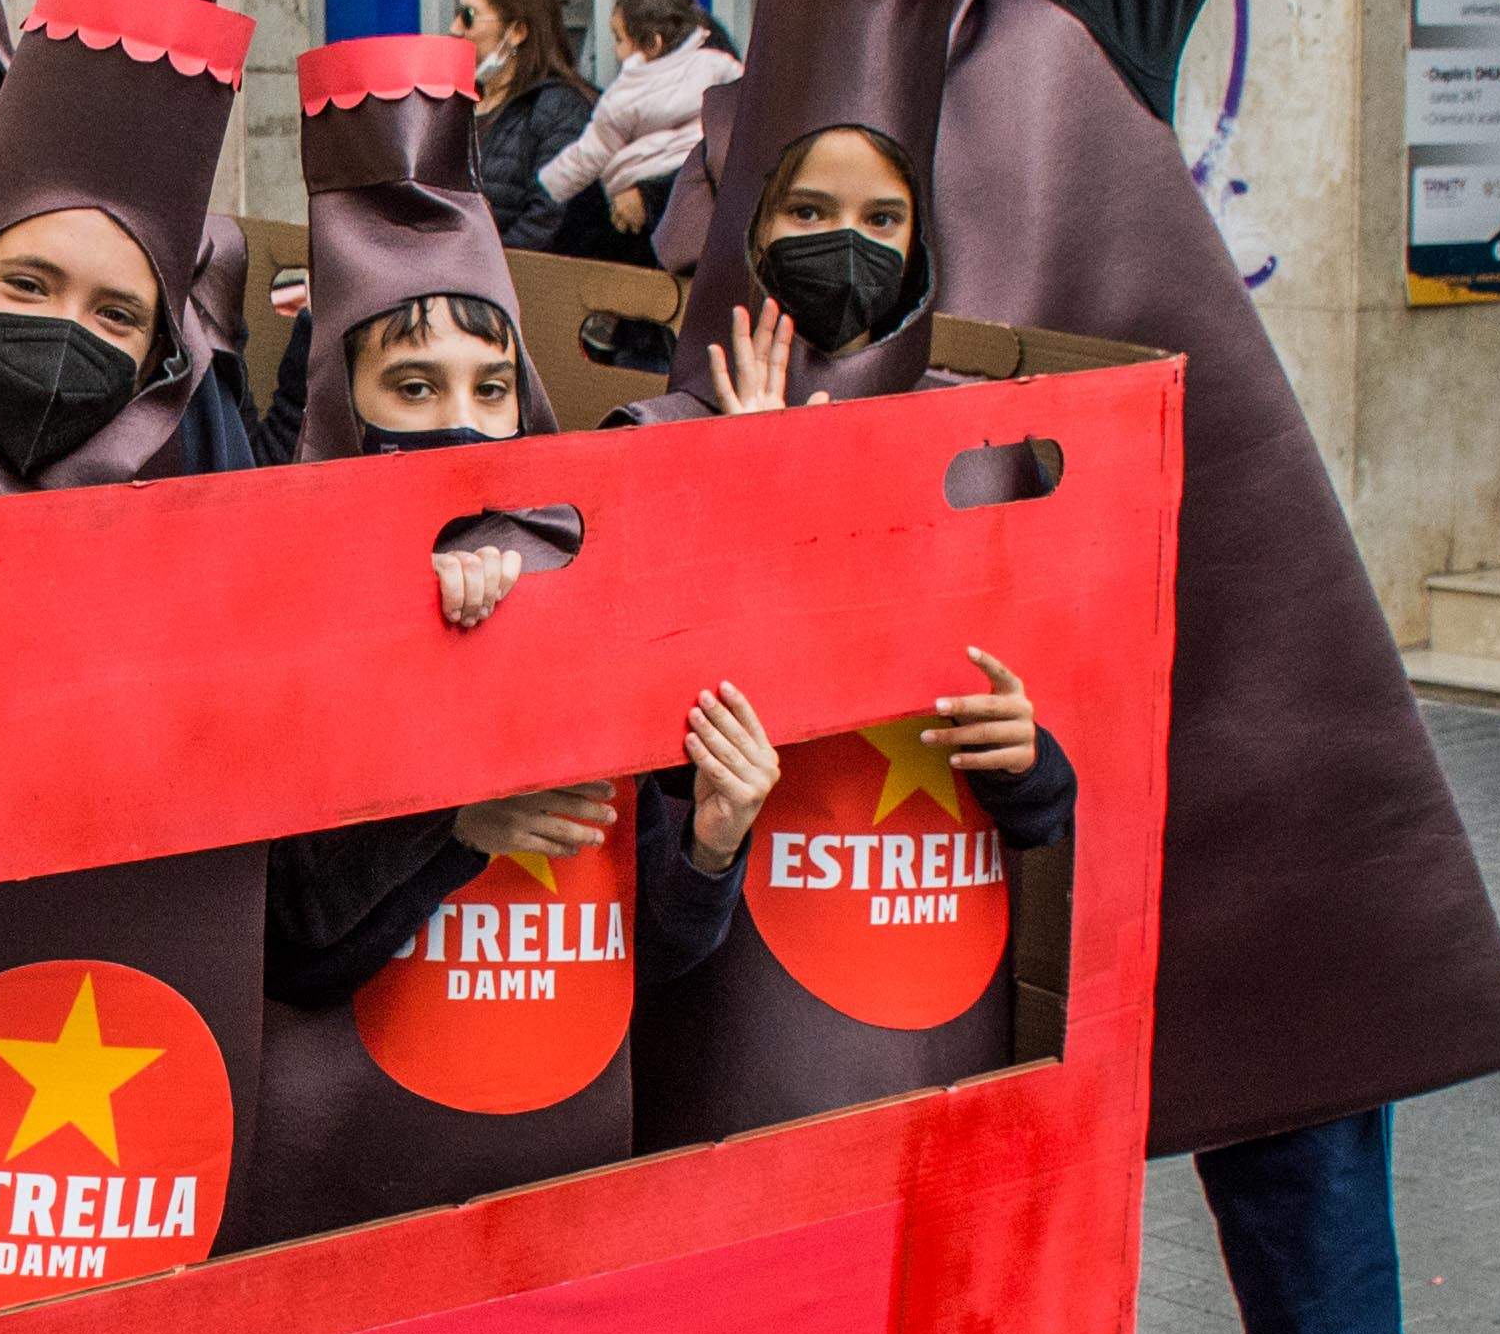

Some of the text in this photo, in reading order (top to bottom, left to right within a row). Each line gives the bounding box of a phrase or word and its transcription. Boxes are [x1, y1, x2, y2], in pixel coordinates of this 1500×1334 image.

[770, 828, 1003, 890] ESTRELLA
[391, 901, 626, 963] TRELLA
[870, 893, 958, 926] DAMM
[447, 969, 556, 1001] DAMM
